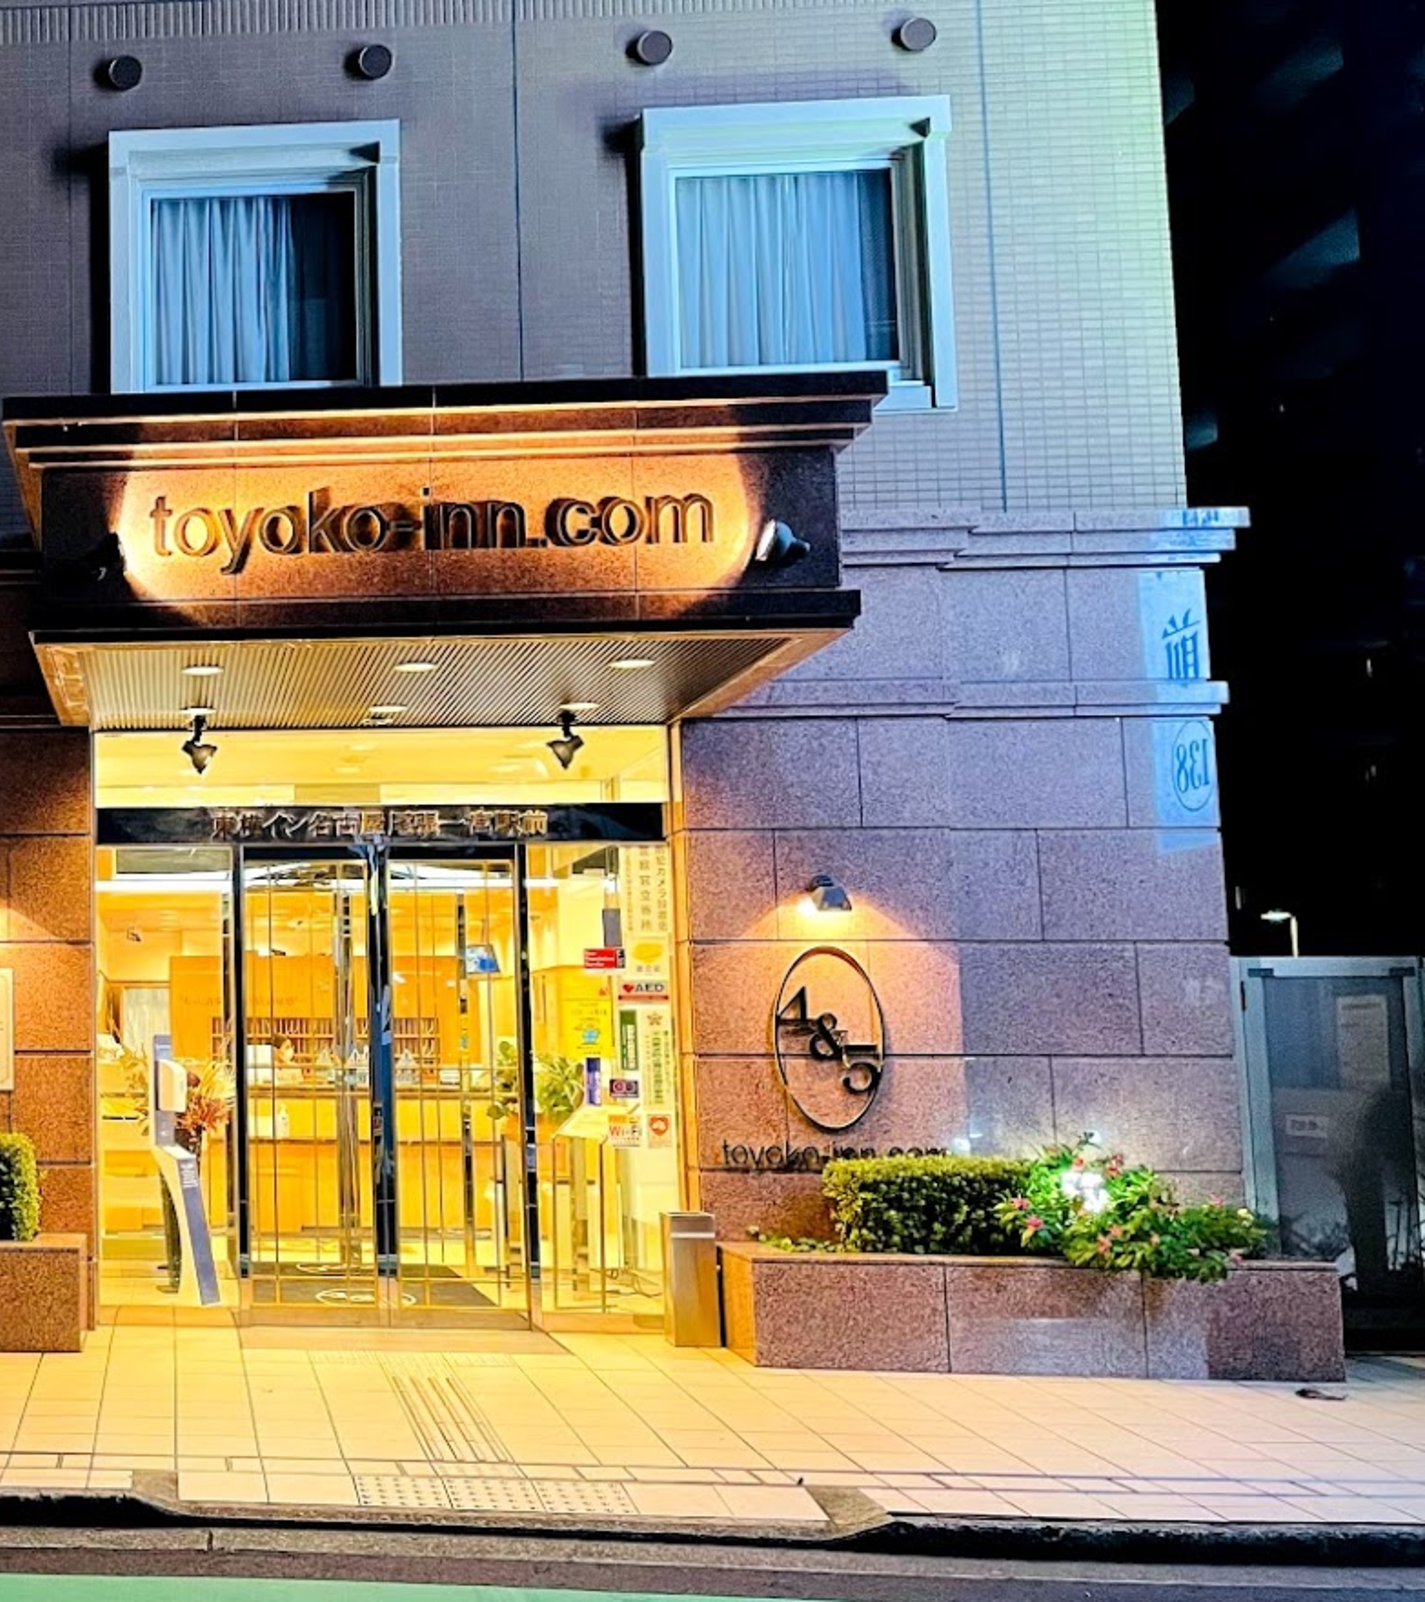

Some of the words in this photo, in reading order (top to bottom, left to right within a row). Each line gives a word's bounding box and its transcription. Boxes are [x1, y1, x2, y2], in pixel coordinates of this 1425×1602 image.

[149, 487, 715, 575] toyoko-inn.com
[211, 809, 549, 840] 東横イン名古屋尾張一宮駅前
[635, 983, 665, 993] AED
[610, 1125, 642, 1136] Wi-Fi
